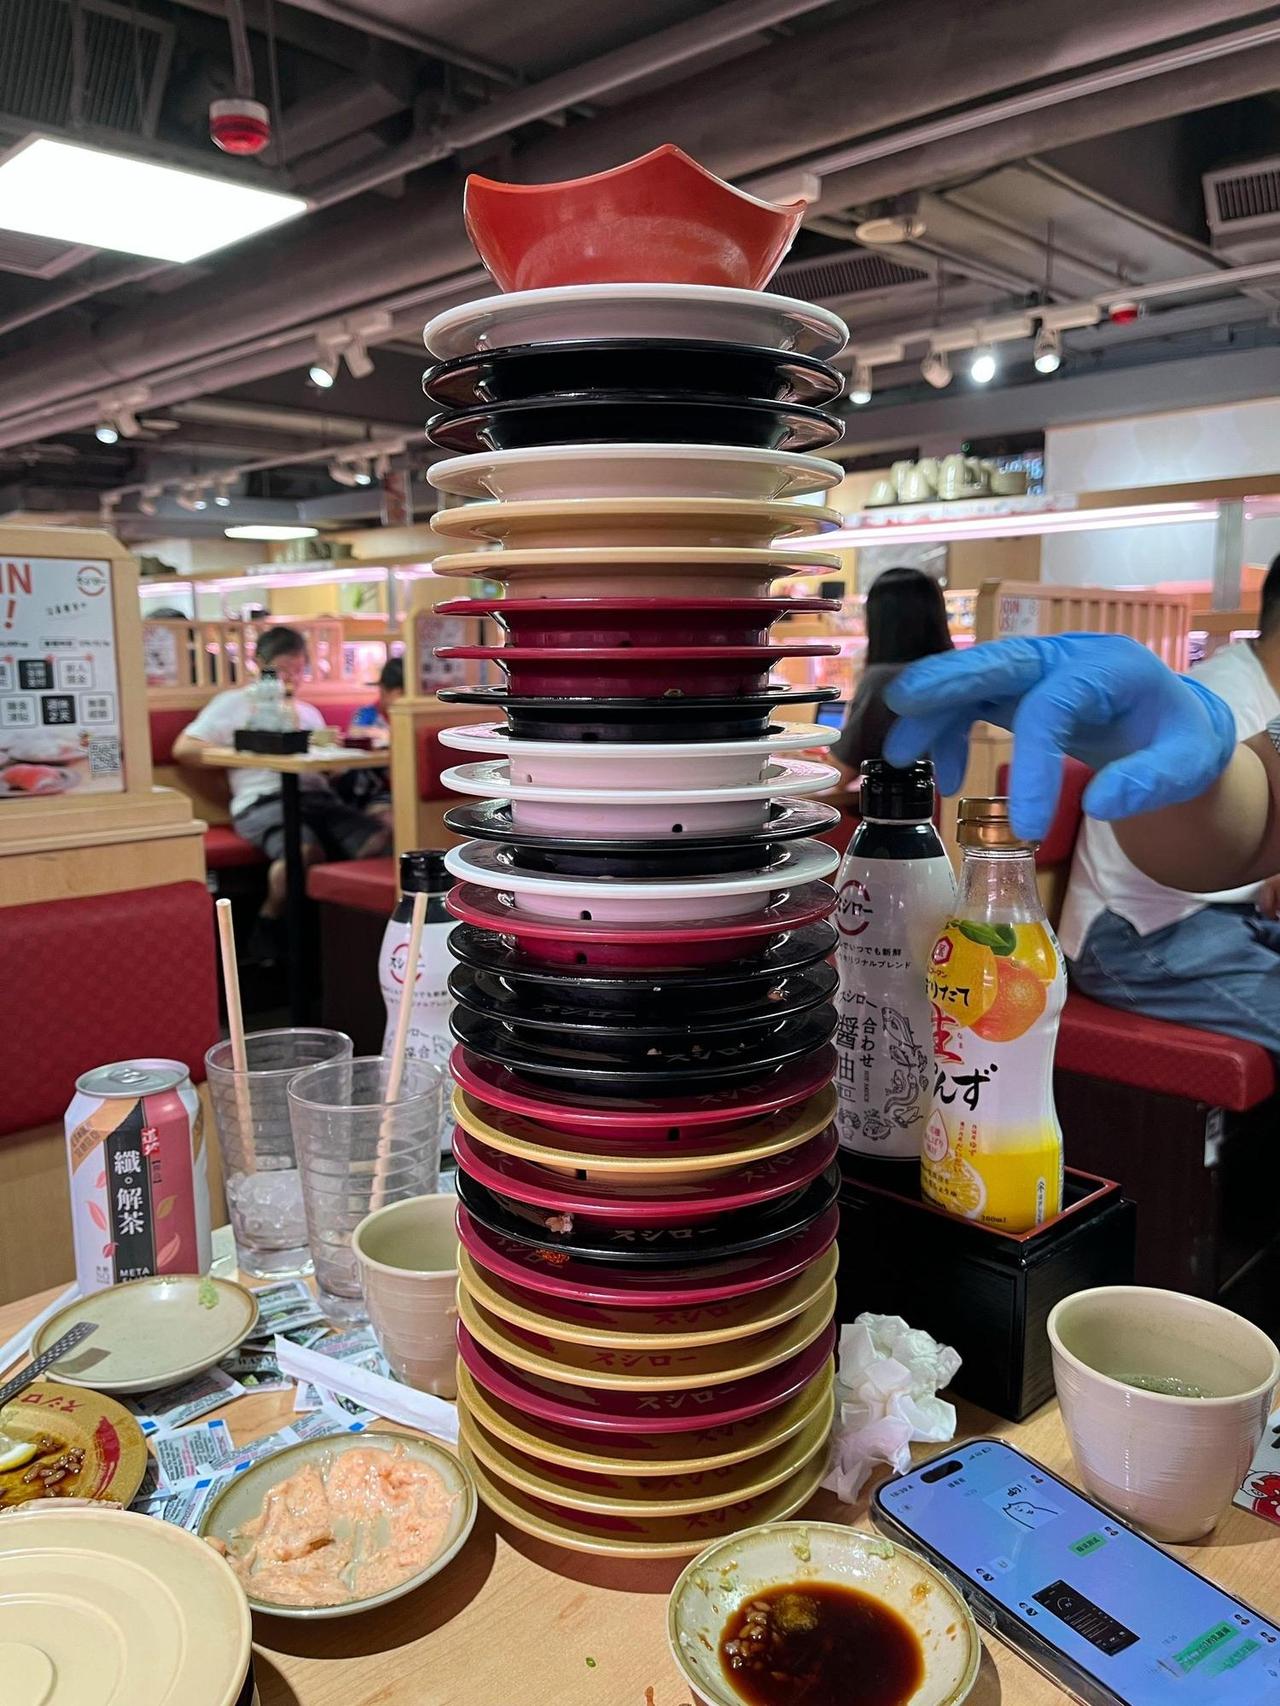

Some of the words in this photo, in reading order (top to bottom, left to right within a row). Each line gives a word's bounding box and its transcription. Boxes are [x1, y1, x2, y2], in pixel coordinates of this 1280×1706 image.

[391, 956, 425, 969] スシー
[860, 1016, 877, 1068] 合わせ
[610, 1227, 719, 1242] スシロー
[590, 1353, 698, 1368] スシロー
[21, 1393, 85, 1412] スシロ
[636, 1385, 736, 1410] スシロー
